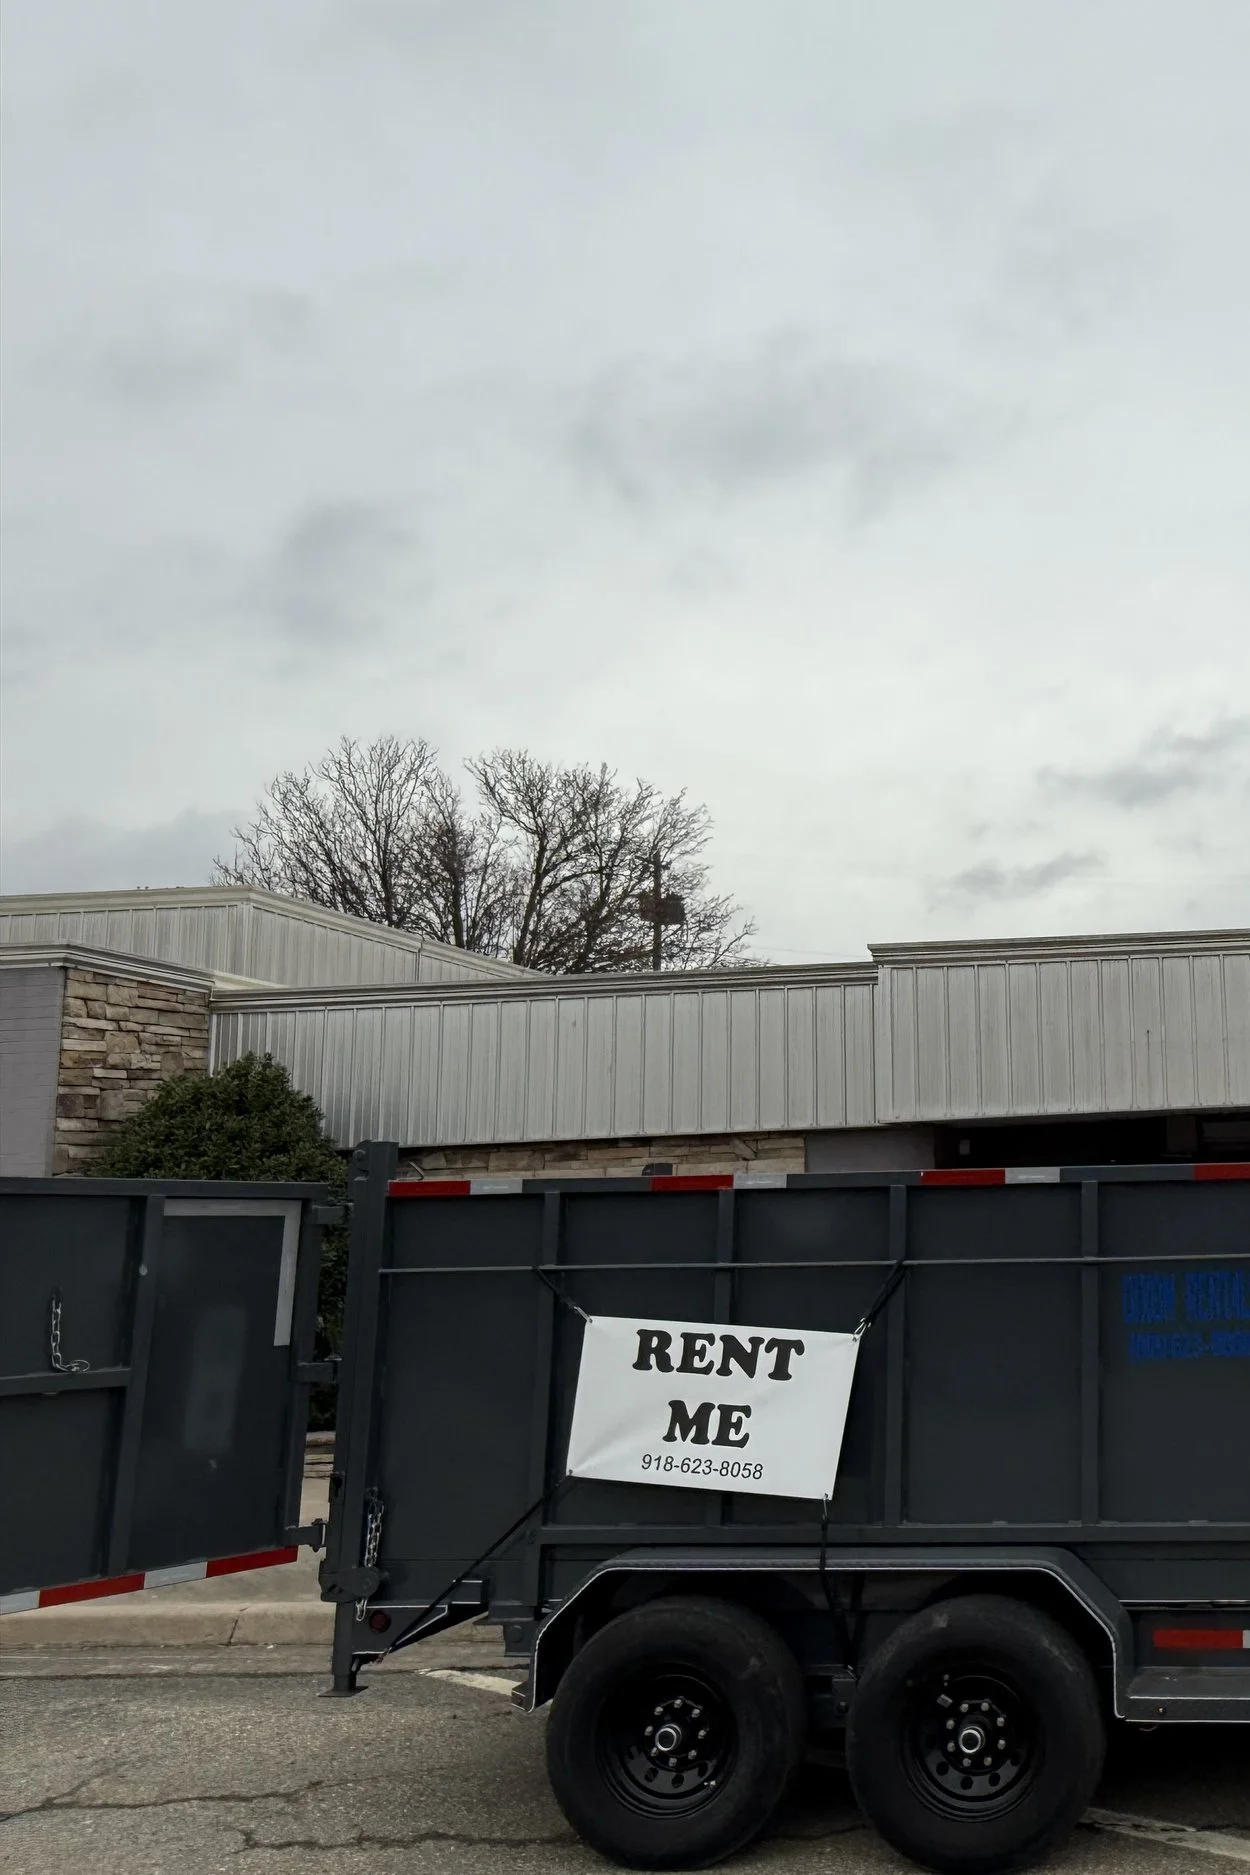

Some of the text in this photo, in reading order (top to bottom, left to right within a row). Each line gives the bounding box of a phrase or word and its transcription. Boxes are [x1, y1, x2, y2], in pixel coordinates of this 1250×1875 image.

[632, 1328, 806, 1381] RENT
[662, 1400, 752, 1448] ME
[641, 1453, 764, 1480] 918-623-8058
